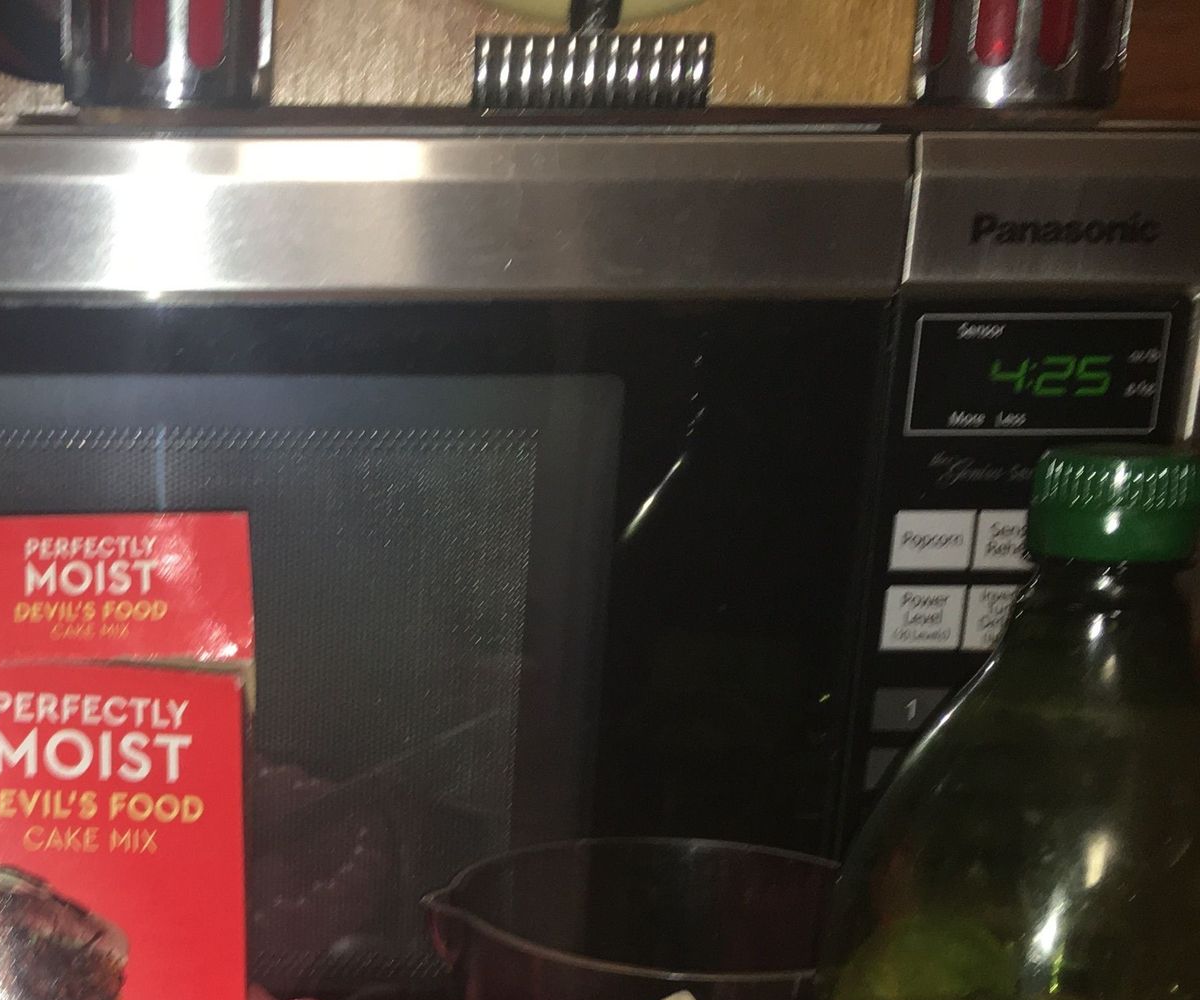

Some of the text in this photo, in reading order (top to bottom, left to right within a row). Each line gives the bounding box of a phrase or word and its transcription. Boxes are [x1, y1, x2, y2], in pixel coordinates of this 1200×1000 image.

[971, 211, 1160, 244] Panasonic
[957, 321, 1007, 340] Sensor
[990, 354, 1114, 397] 4:25
[947, 410, 1028, 428] More Less
[24, 534, 157, 560] PERFECTLY
[902, 529, 964, 551] Popcorn
[24, 559, 159, 597] MOIST
[13, 599, 169, 624] DEVIL'S FOOD
[901, 591, 950, 609] Power
[905, 608, 944, 626] Level
[50, 622, 131, 641] CAKE MIX
[904, 699, 918, 721] 1
[109, 792, 205, 824] FOOD
[22, 824, 160, 855] CAKE MIX
